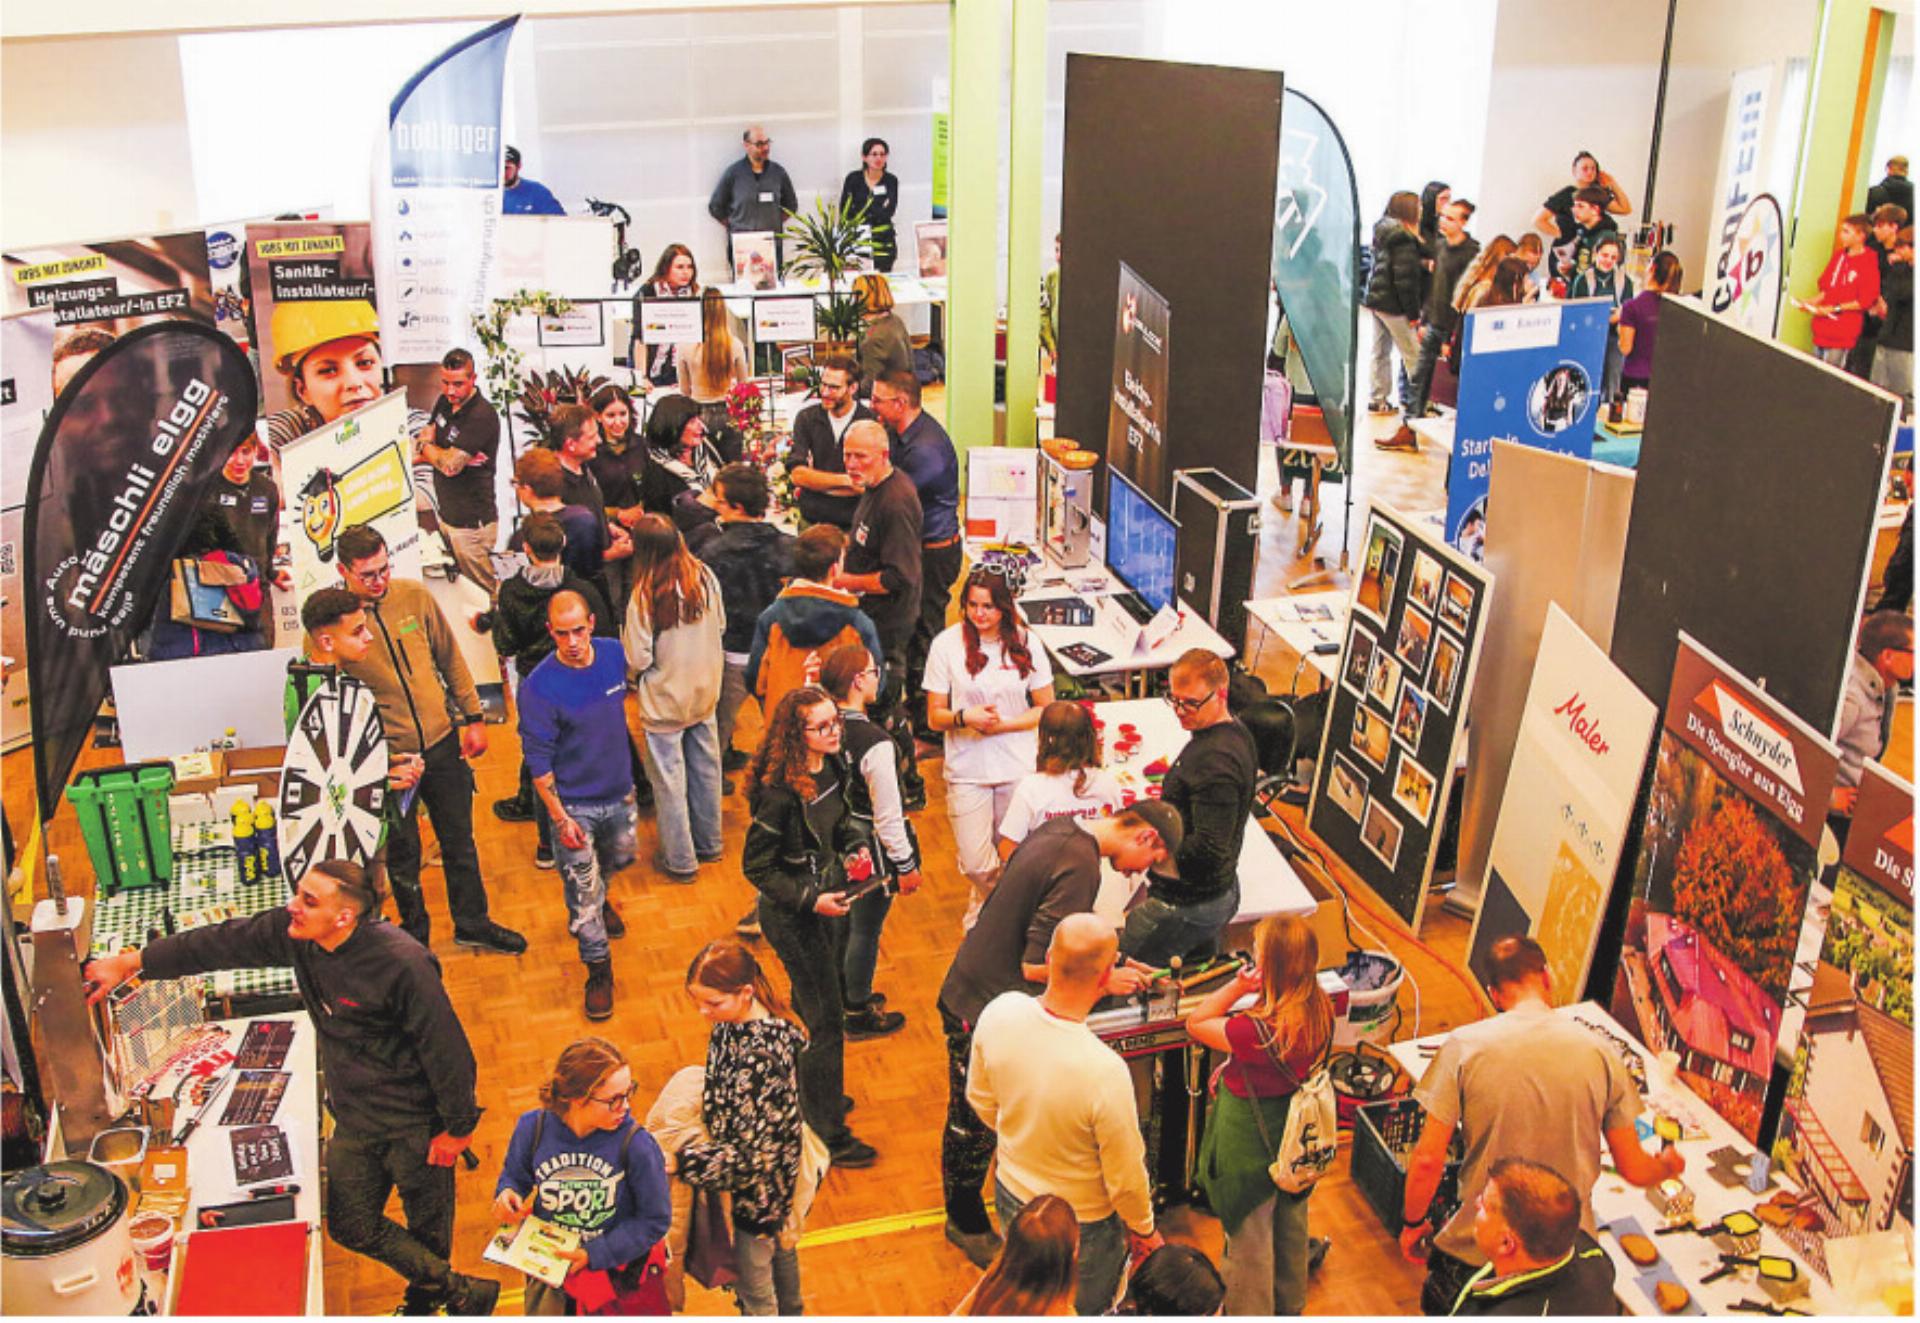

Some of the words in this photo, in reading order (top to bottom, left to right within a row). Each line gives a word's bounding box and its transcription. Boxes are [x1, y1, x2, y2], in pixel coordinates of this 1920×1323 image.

[274, 264, 335, 279] Sanitär-
[34, 285, 113, 304] Heizungs-
[157, 294, 185, 310] EFZ
[276, 282, 375, 298] Installateur/-
[68, 462, 156, 609] mäschli
[152, 378, 212, 456] elgg
[46, 556, 78, 590] Auto
[1554, 692, 1610, 756] Maler
[1728, 709, 1792, 768] Schnyder
[1687, 712, 1705, 739] Die
[1707, 728, 1752, 778] Spengler
[1754, 771, 1775, 796] aus
[1777, 784, 1804, 824] Elgg
[1873, 847, 1900, 880] Die
[535, 1152, 614, 1180] TRADITION
[540, 1170, 625, 1212] SPORT
